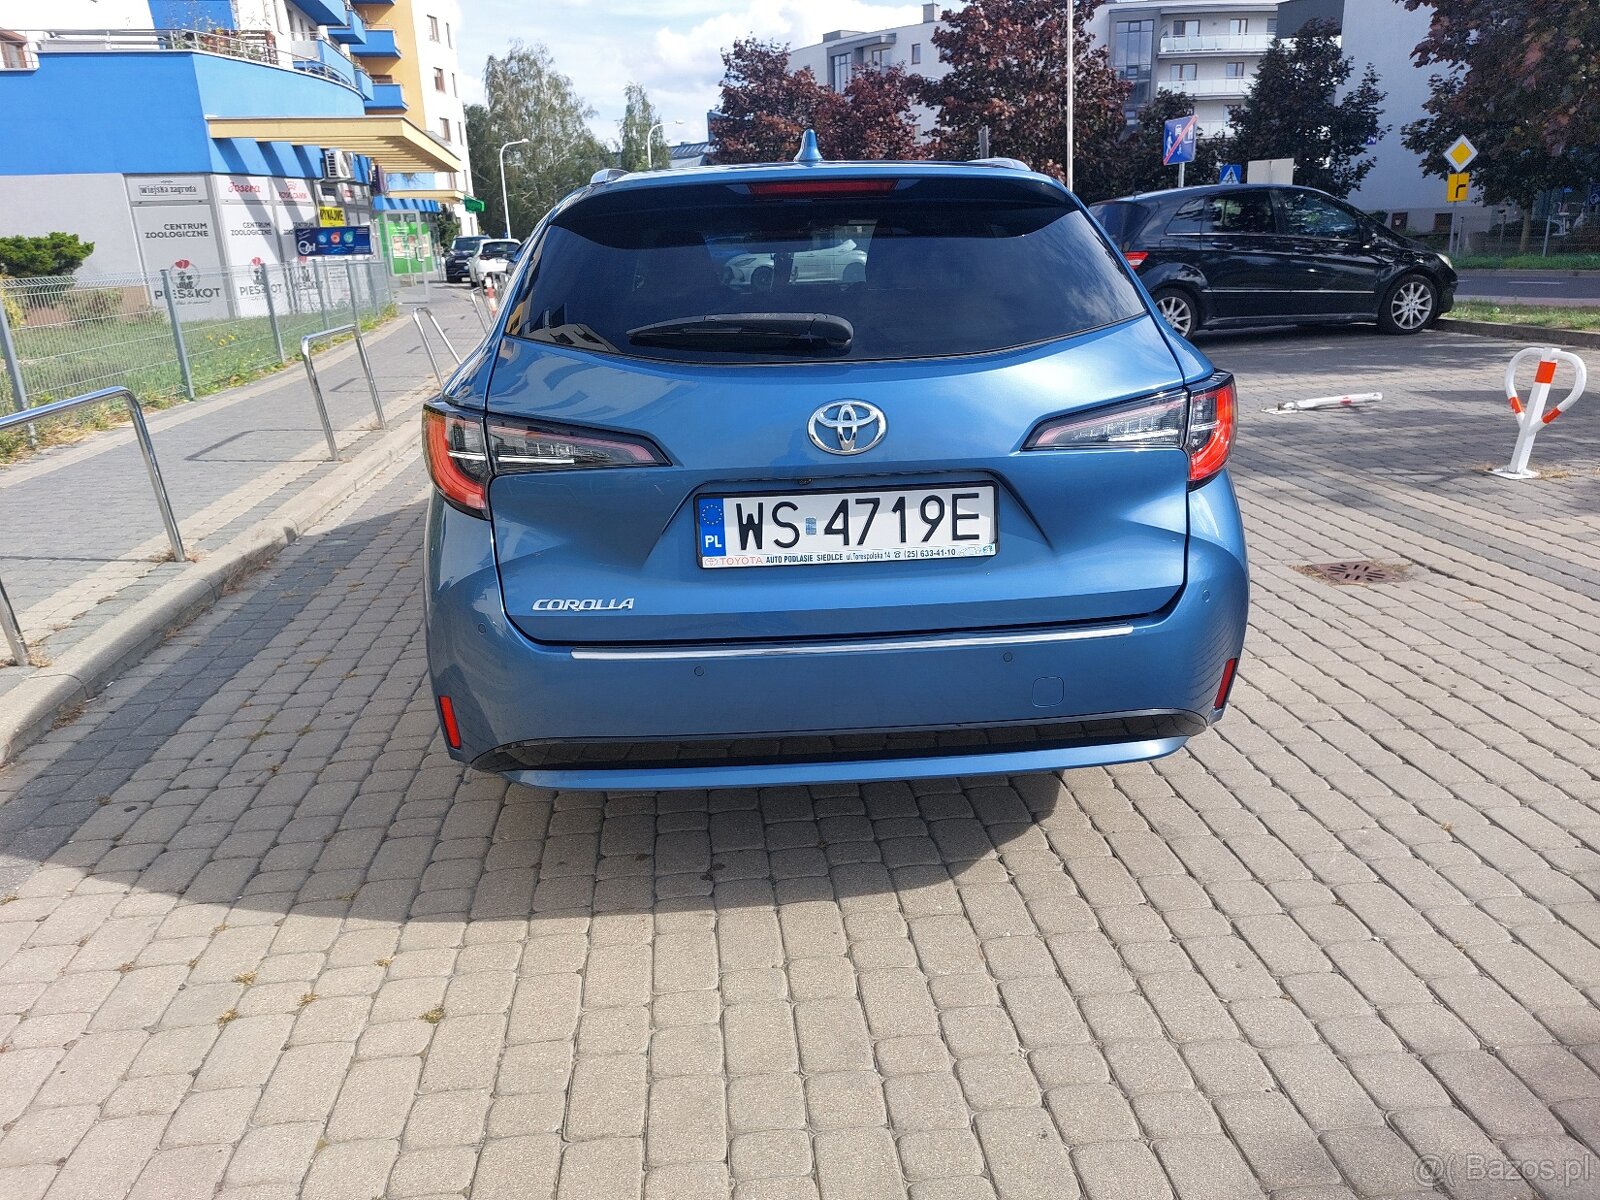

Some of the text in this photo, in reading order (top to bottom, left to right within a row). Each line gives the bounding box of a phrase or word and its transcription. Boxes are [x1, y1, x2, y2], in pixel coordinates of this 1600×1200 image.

[163, 222, 208, 231] CENTRUM
[242, 221, 271, 229] CENTRUM
[145, 230, 209, 239] ZOOLOGICZNE
[735, 492, 981, 551] WS 4719E
[705, 535, 722, 548] PL
[720, 556, 763, 566] TOYOTA
[765, 555, 783, 564] AUTO
[783, 554, 814, 563] PODLASIE
[816, 553, 844, 562] SIEDLCE
[884, 551, 891, 559] 14
[904, 549, 918, 558] (25)
[920, 548, 956, 557] 633-41-10
[532, 597, 635, 612] COROLLA
